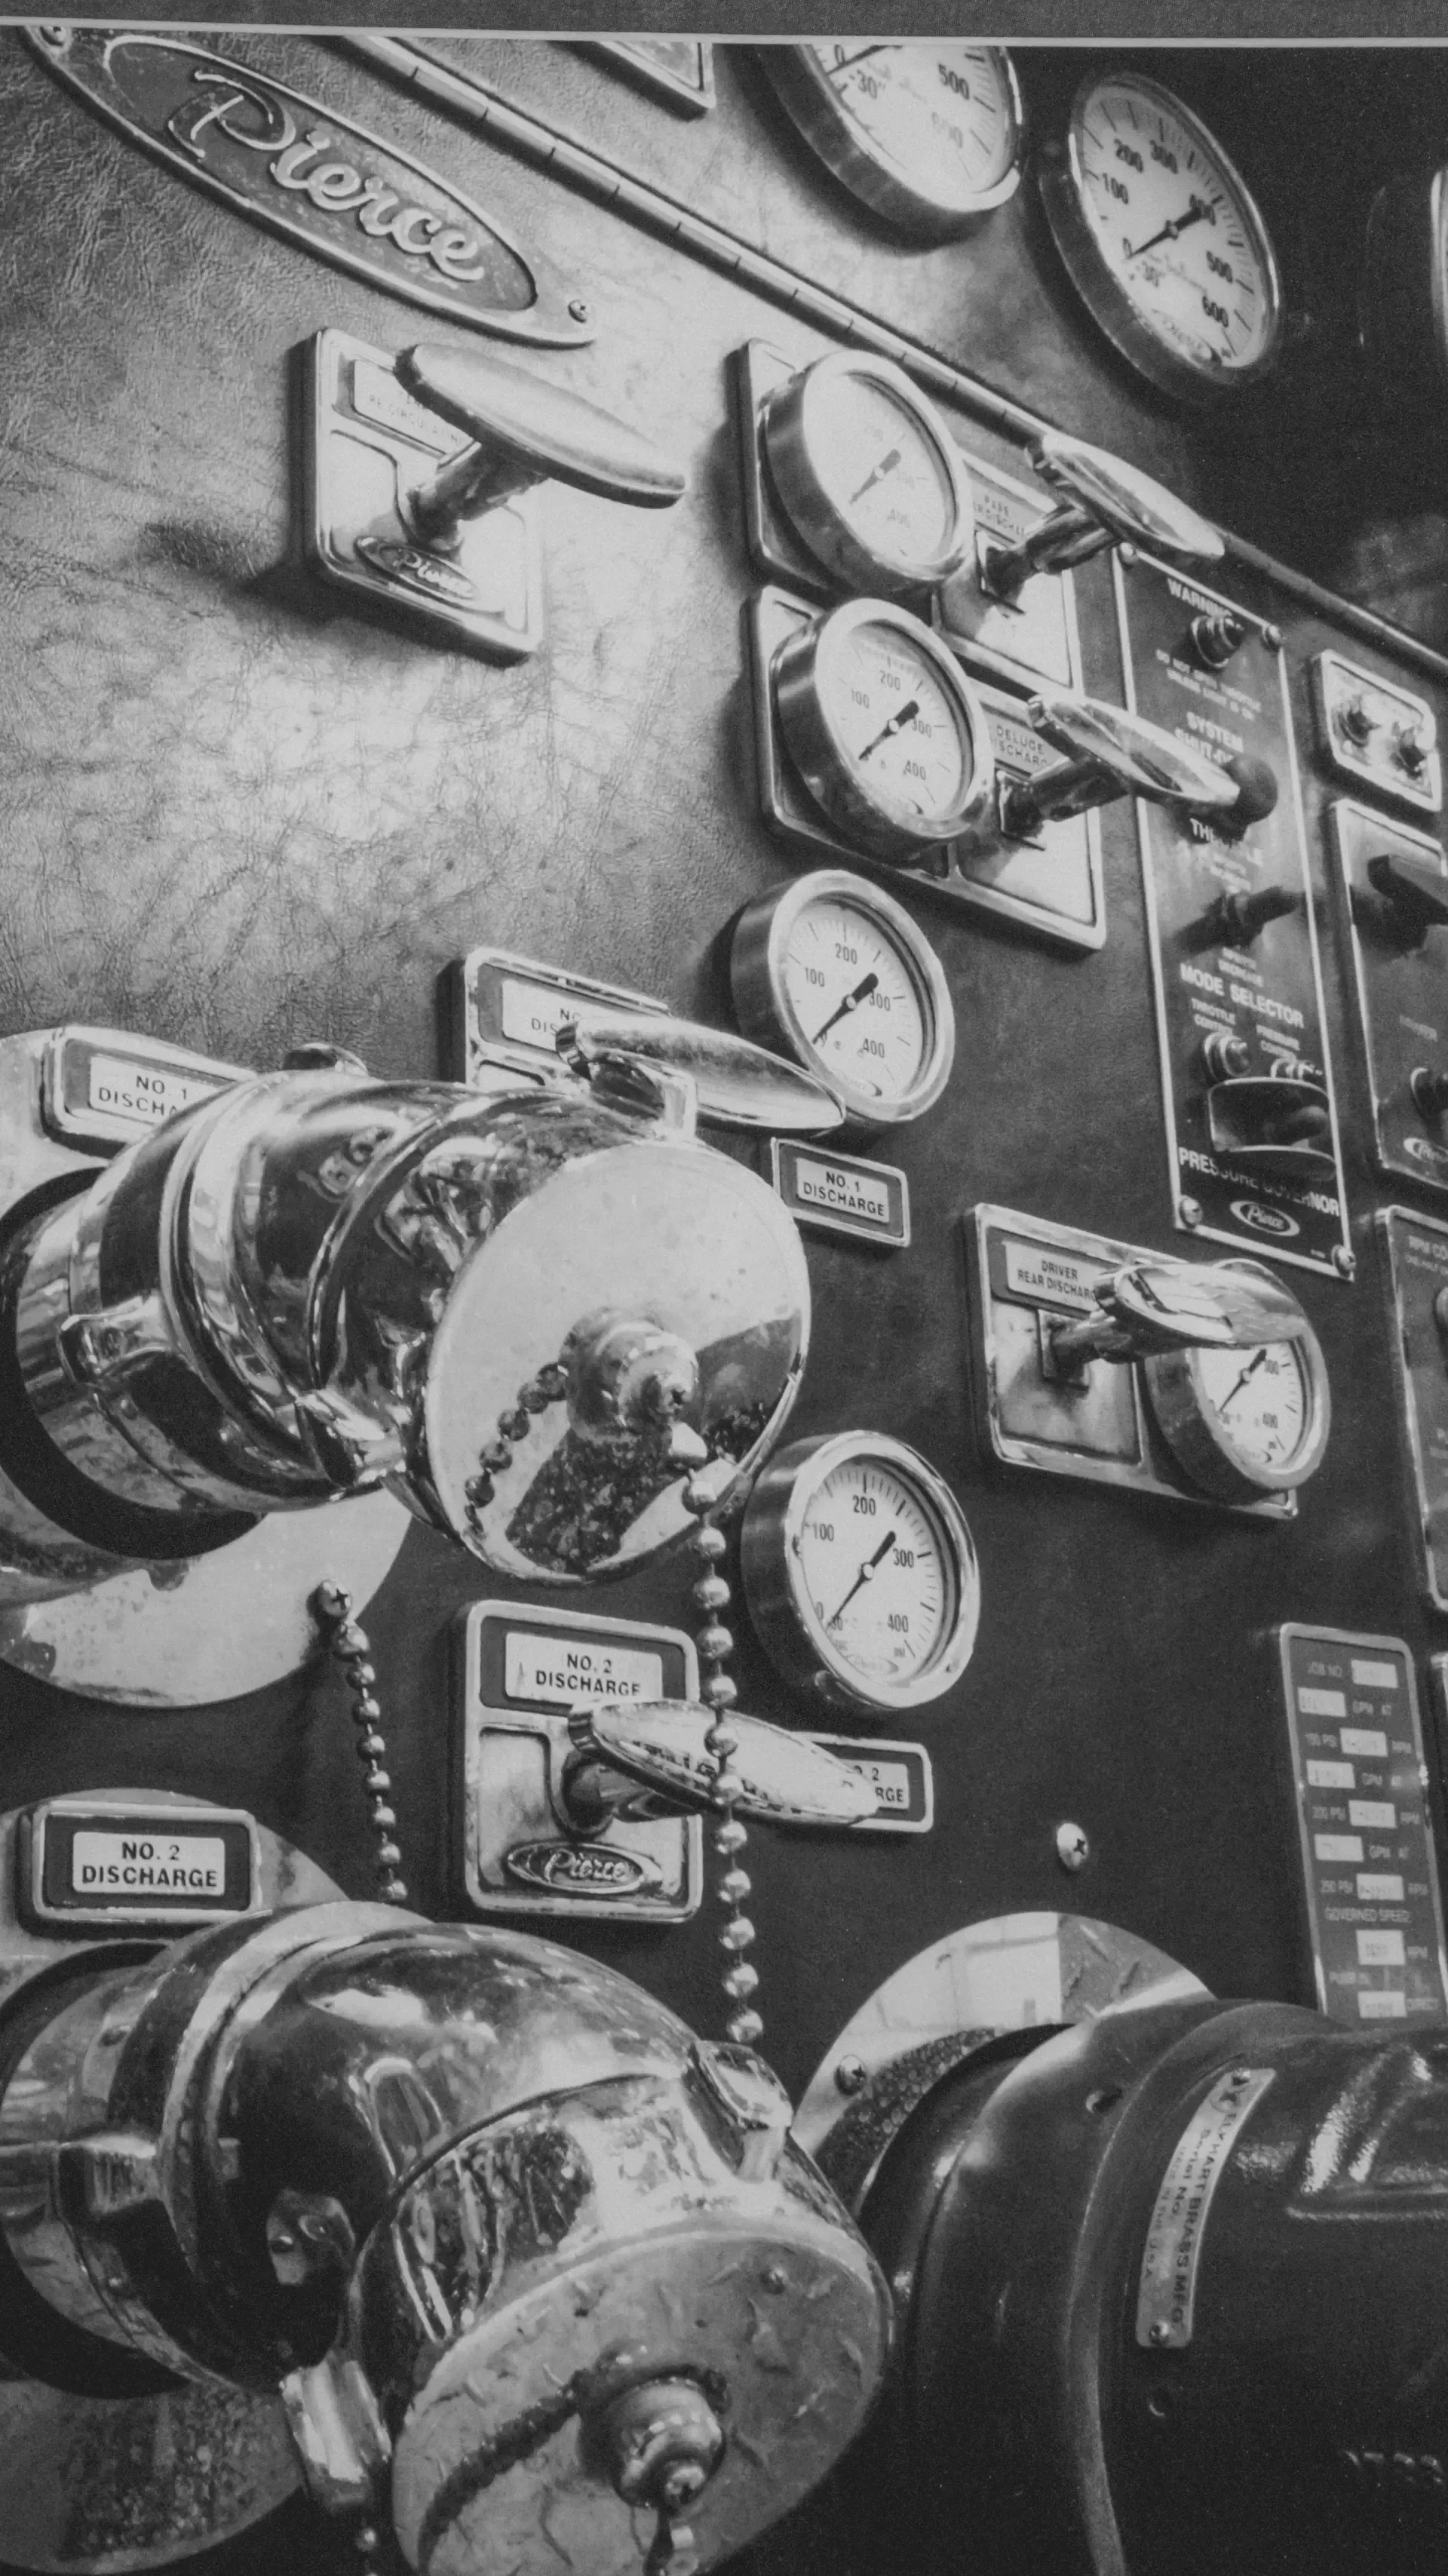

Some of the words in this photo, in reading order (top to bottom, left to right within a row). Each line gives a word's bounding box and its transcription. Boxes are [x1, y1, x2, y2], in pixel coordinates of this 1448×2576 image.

[939, 63, 970, 100] 500
[1114, 138, 1144, 173] 200
[1149, 140, 1179, 174] 300
[168, 69, 485, 281] Pierce
[1102, 172, 1129, 205] 100
[1207, 250, 1233, 284] 500
[1202, 295, 1229, 329] 600
[879, 668, 901, 692] 200
[850, 688, 870, 710] 100
[911, 717, 933, 739] 300
[996, 723, 1045, 756] DELUGE
[904, 760, 927, 781] 400
[835, 942, 857, 966] 200
[804, 966, 825, 987] 100
[867, 990, 891, 1012] 300
[1180, 962, 1226, 996] MODE
[1229, 983, 1305, 1030] SELECTOR
[863, 1037, 885, 1058] 400
[99, 1086, 178, 1117] DISCHA
[182, 1088, 187, 1101] 1
[827, 1171, 851, 1190] NO.
[854, 1180, 860, 1193] 1
[803, 1181, 885, 1217] DISCHARGE
[1017, 1269, 1045, 1287] REAR
[1042, 1260, 1078, 1281] DRIVER
[852, 1494, 876, 1516] 200
[813, 1523, 834, 1543] 100
[893, 1547, 915, 1569] 300
[887, 1613, 910, 1634] 400
[567, 1653, 597, 1672] NO.
[603, 1659, 612, 1675] 2
[535, 1669, 640, 1696] DISCHARGE
[121, 1841, 161, 1861] NO.
[168, 1844, 180, 1861] 2
[82, 1865, 217, 1887] DISCHARGE
[543, 1850, 630, 1884] Pierce
[1176, 2197, 1202, 2268] BRASS
